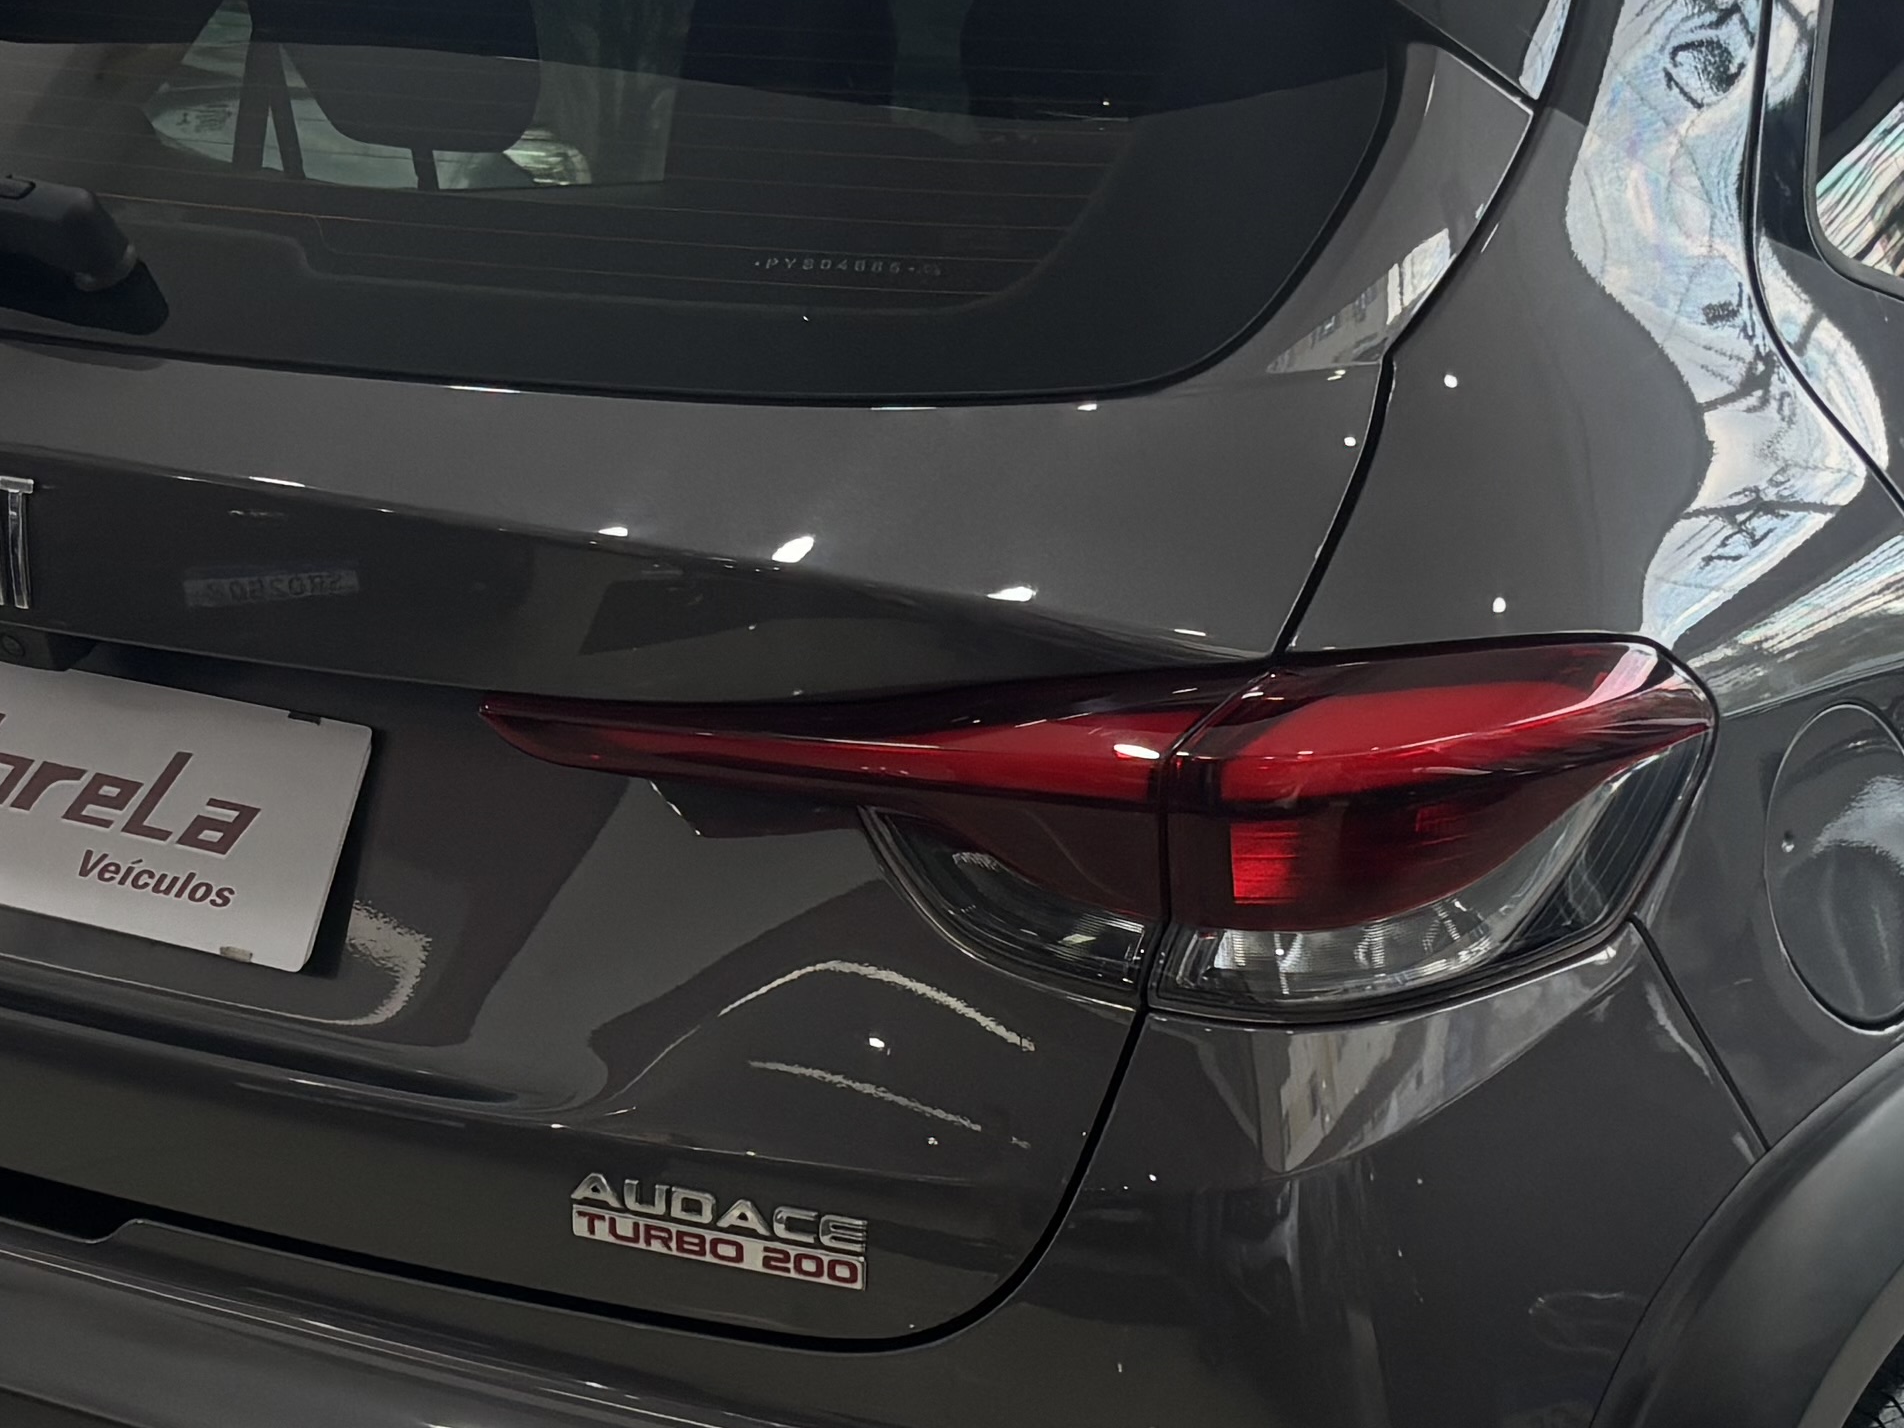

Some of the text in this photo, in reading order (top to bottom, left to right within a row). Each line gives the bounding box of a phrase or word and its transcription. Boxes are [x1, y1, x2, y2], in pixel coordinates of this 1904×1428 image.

[77, 848, 237, 909] Veículos
[571, 1172, 867, 1253] AUDACE
[575, 1209, 860, 1286] TURBO 200
